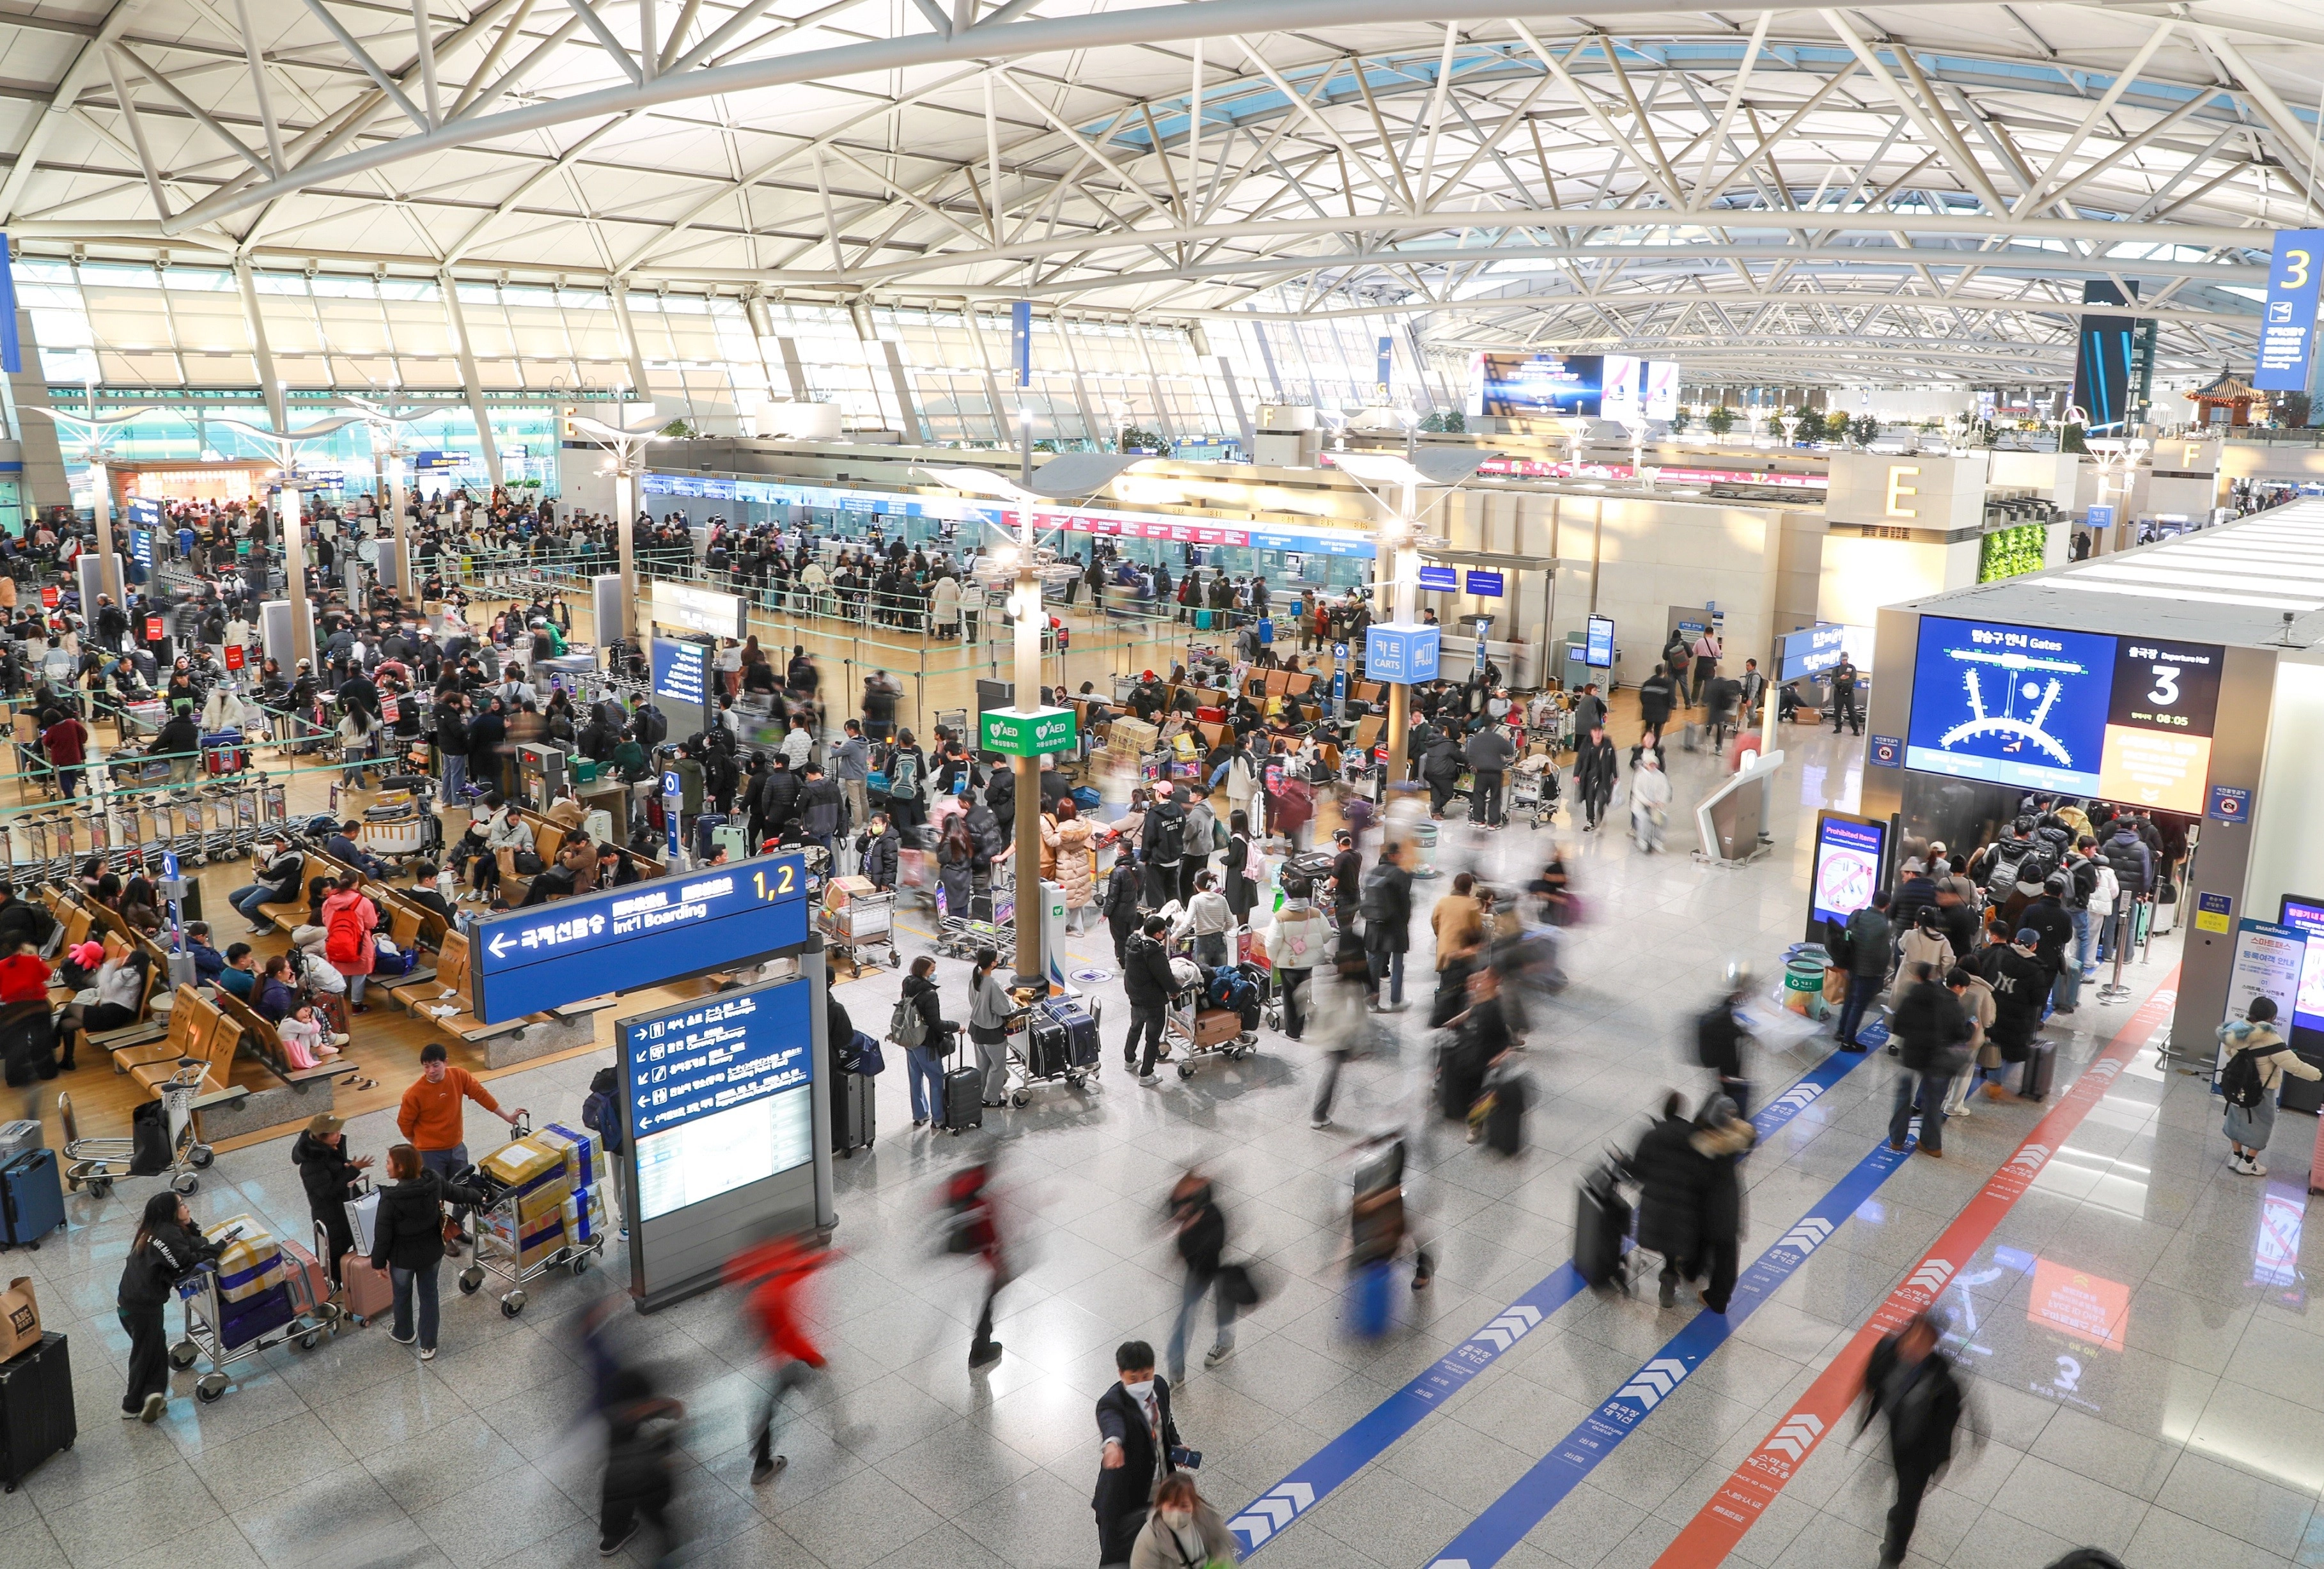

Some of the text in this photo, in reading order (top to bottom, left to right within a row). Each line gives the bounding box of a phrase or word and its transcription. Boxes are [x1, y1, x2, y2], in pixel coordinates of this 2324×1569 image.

[2281, 249, 2311, 288] 3
[1012, 368, 1022, 386] F
[563, 407, 577, 435] E
[1263, 407, 1274, 427] F
[2182, 444, 2201, 468] F
[1885, 465, 1921, 518] E
[1971, 629, 2063, 652] 탑승구 안내 Gates
[1376, 640, 1400, 657] 카트
[2128, 646, 2210, 664] 출국장 Departure Hall
[1375, 659, 1400, 669] CARTS
[2147, 664, 2180, 705] 3
[2156, 714, 2188, 726] 08:05
[1002, 726, 1018, 737] AED
[1049, 723, 1066, 734] AED
[990, 738, 1018, 749] 자동심장충격기
[1036, 737, 1066, 748] 자동심장충격기
[2217, 788, 2246, 796] 사진촬영금지
[1826, 827, 1876, 843] Prohibited Items
[753, 865, 794, 901] 1,2
[644, 903, 706, 927] Boarding
[2289, 908, 2311, 919] 항공기
[520, 914, 605, 949] 국제선탑승
[2255, 925, 2288, 935] SMARTPASS
[2250, 937, 2291, 951] 스마트패스
[2243, 950, 2295, 967] 등록여객 안내
[1993, 971, 2018, 994] NY
[2242, 984, 2265, 992] 스마트패스
[705, 1005, 756, 1024] Food, Beverages
[687, 1029, 746, 1050] Currency Exchange
[708, 1055, 733, 1067] Nursery
[728, 1058, 789, 1082] Meeting Point (East)
[2000, 1167, 2033, 1178] 패스전용
[2008, 1165, 2033, 1175] 스마트
[153, 1238, 165, 1249] ARE
[1768, 1253, 1795, 1265] 대기선
[1772, 1249, 1800, 1261] 출국장
[1758, 1261, 1790, 1274] DEPARTURE
[1761, 1265, 1780, 1274] QUEUE
[1894, 1290, 1931, 1306] 패스전용
[1901, 1288, 1931, 1300] 스마트
[1458, 1349, 1486, 1364] 대기선
[1463, 1344, 1492, 1359] 출국장
[1442, 1359, 1475, 1375] DEPARTURE
[1445, 1365, 1465, 1375] QUEUE
[1430, 1376, 1449, 1387] 出境
[1415, 1388, 1434, 1399] 出国
[1603, 1407, 1634, 1425] 대기선
[1608, 1401, 1640, 1417] 출국장
[1587, 1418, 1625, 1437] DEPARTURE
[1591, 1425, 1614, 1437] QUEUE
[1579, 1437, 1599, 1449] 出境
[1564, 1451, 1585, 1464] 出国
[1757, 1454, 1791, 1471] 스마트
[1746, 1456, 1790, 1479] 패스전용
[1733, 1472, 1751, 1482] FACE
[1759, 1484, 1779, 1494] ONLY
[1720, 1489, 1763, 1510] 人脸认证
